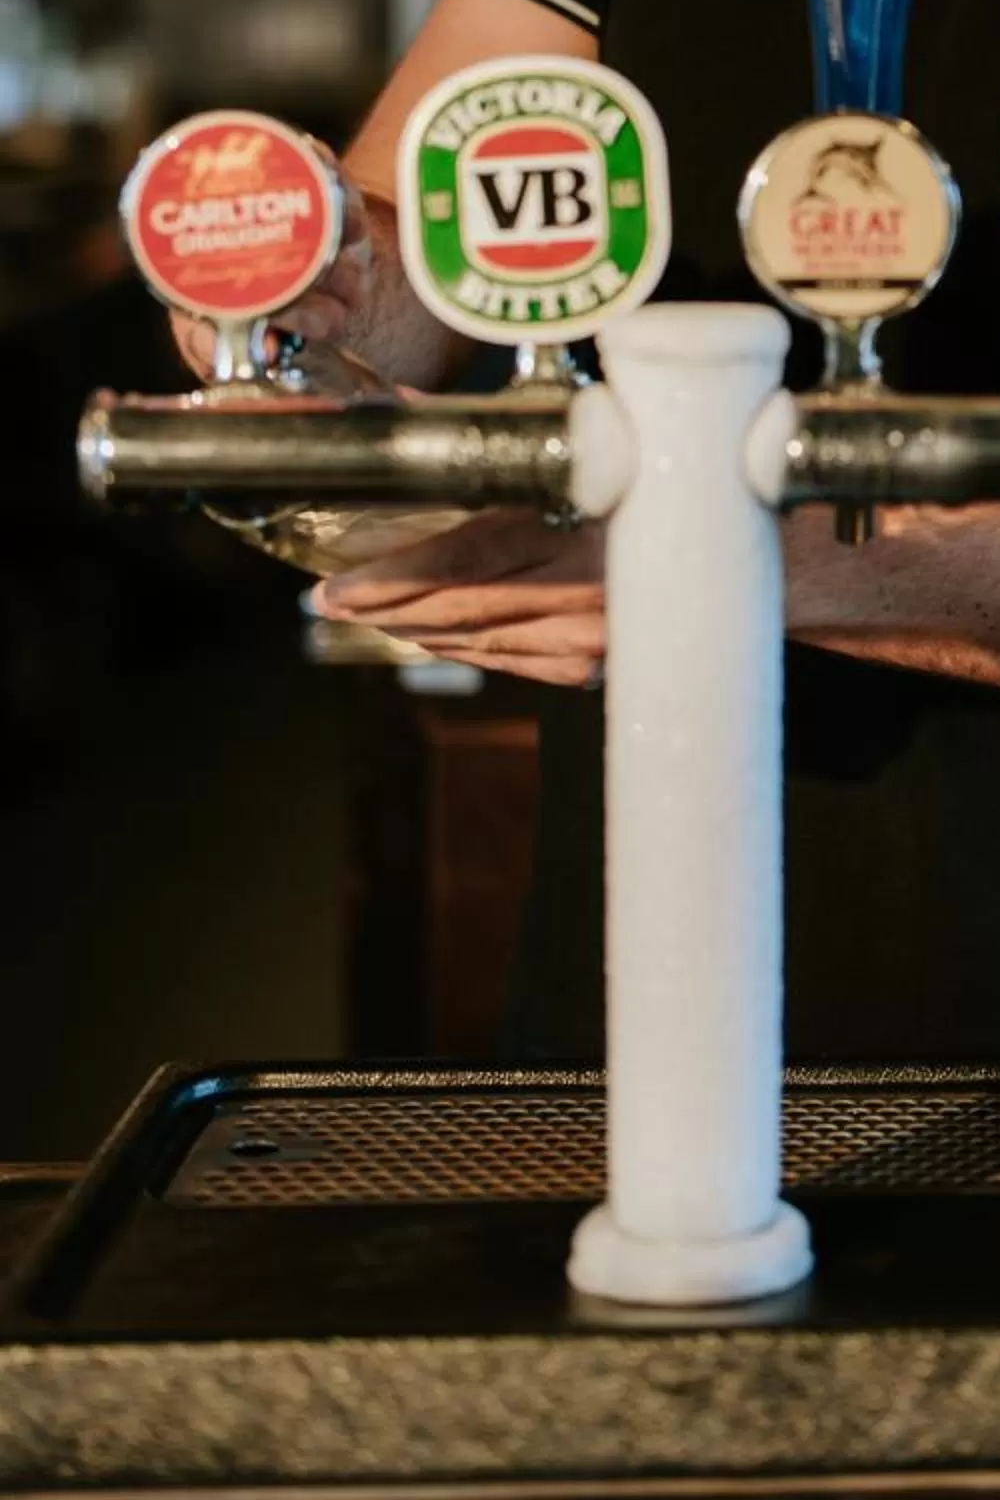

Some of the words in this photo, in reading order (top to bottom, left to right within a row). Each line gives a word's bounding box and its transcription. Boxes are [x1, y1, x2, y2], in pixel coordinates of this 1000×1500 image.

[425, 78, 627, 150] VICTORIA
[477, 167, 592, 230] VB
[456, 259, 629, 323] BITTER
